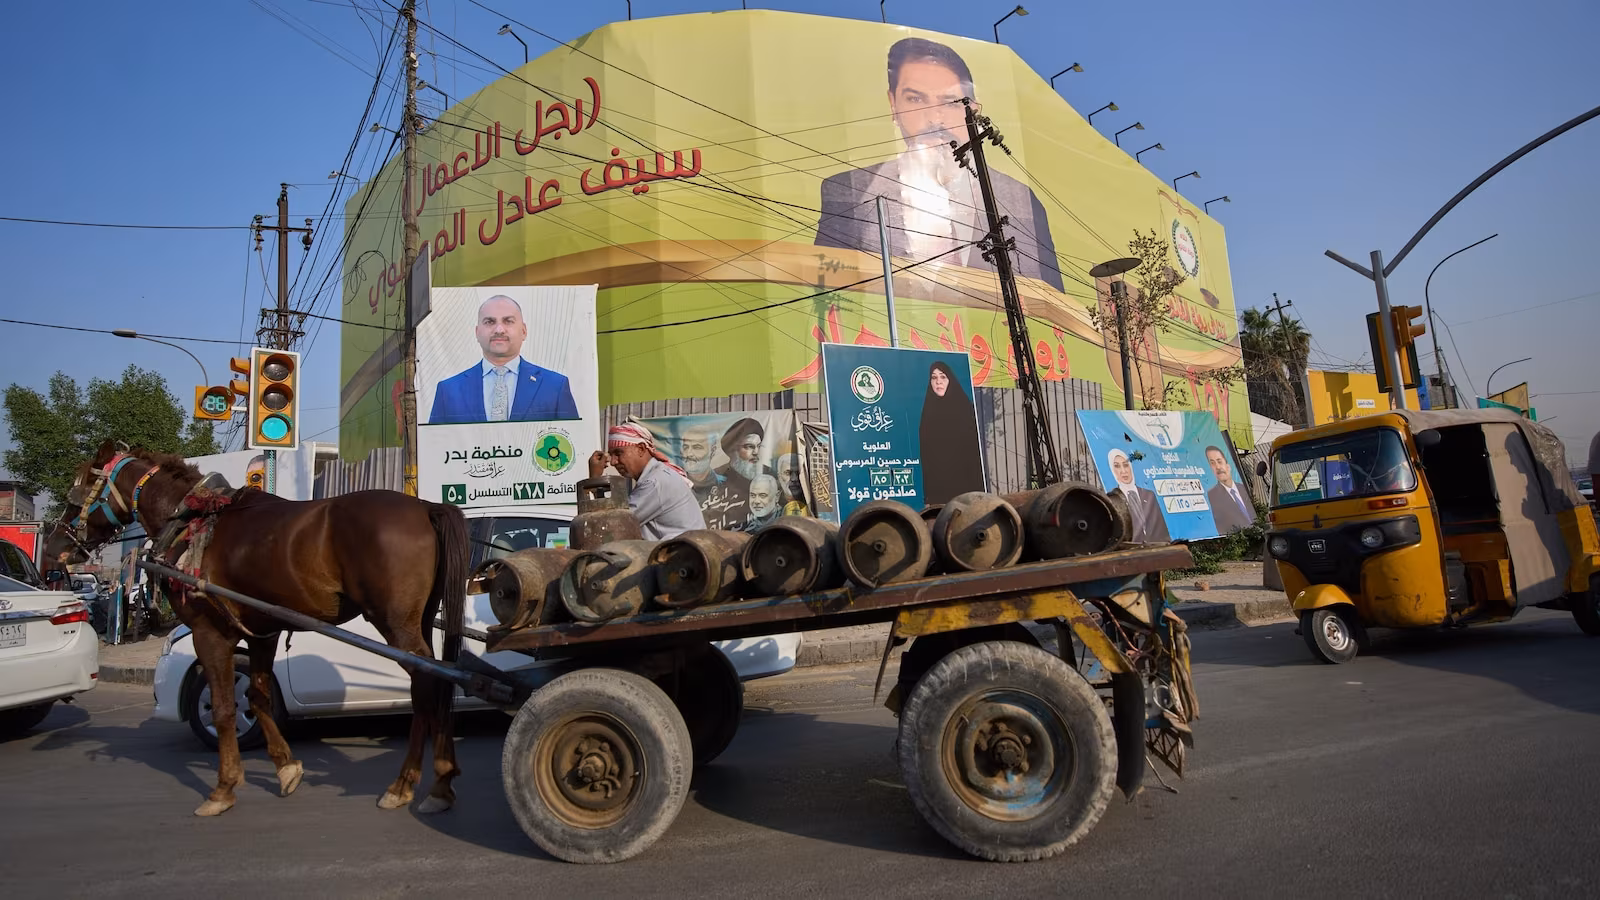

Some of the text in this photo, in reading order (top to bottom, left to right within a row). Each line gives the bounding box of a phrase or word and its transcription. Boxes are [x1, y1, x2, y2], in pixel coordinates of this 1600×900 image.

[580, 147, 702, 195] سيف
[479, 175, 563, 245] عادل
[444, 445, 523, 464] منظمة بدر
[862, 441, 891, 452] العلوية
[835, 456, 919, 471] سحر حسين المرسومي
[874, 475, 887, 485] ٨٥
[447, 483, 576, 502] لقائمة ٢١٨ التسلسل ٥٠
[873, 486, 917, 501] صادقون
